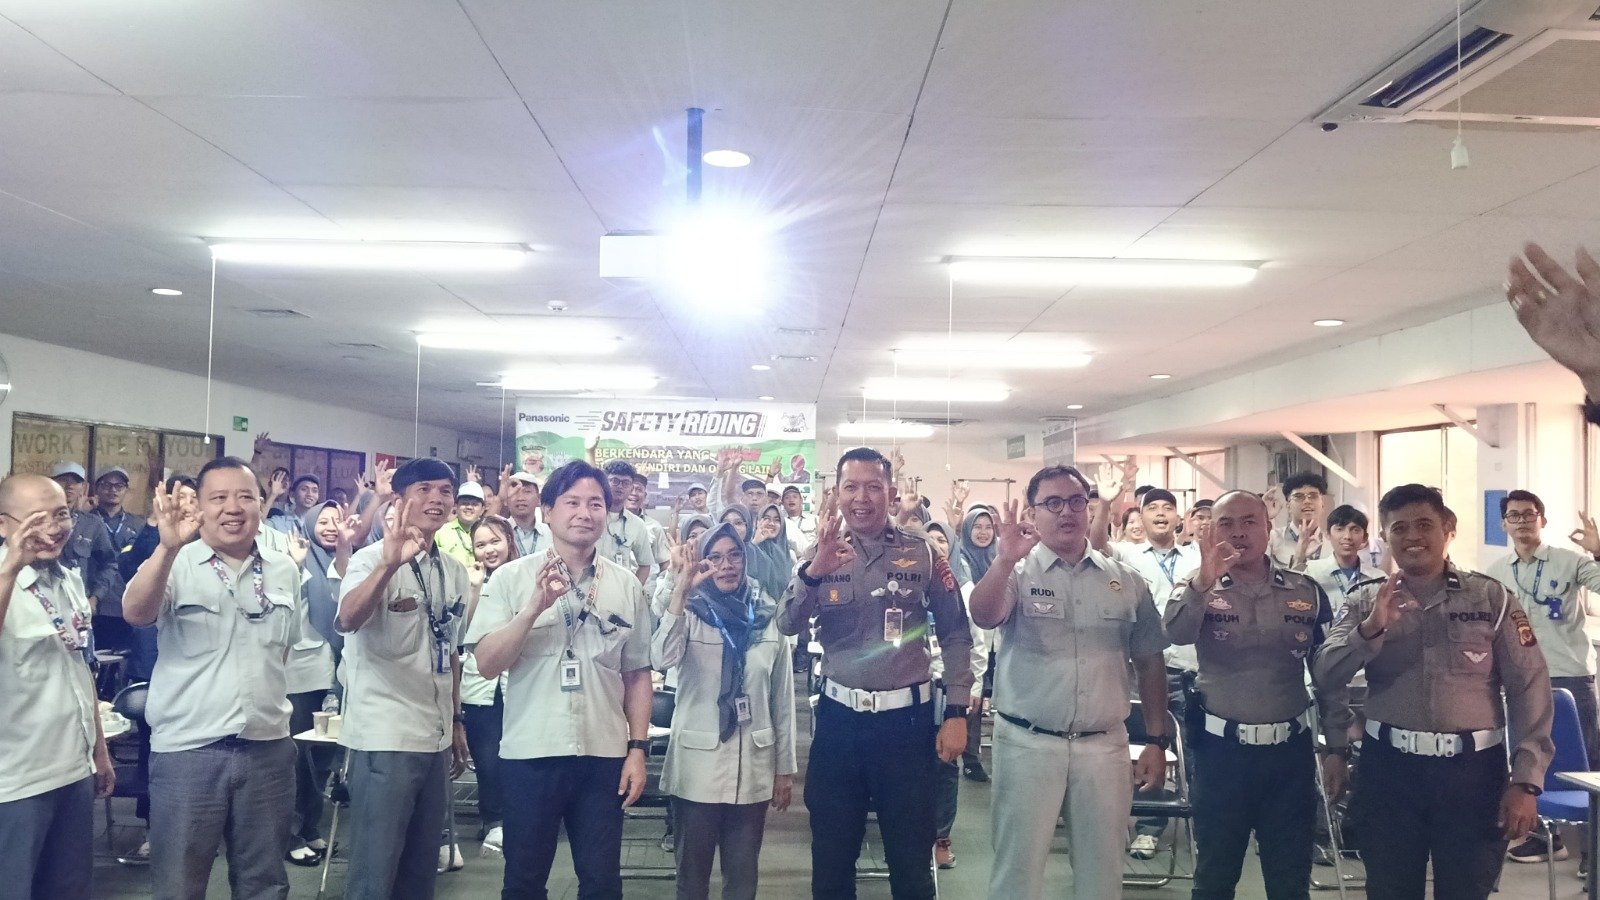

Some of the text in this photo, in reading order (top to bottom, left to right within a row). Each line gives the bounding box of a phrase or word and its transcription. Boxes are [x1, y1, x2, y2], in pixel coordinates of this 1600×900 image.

[519, 413, 570, 423] Panasonic
[601, 410, 757, 436] SAFETY RIDING
[15, 433, 73, 455] WORK
[595, 448, 710, 461] BERKENDARA YANG
[685, 463, 706, 474] DAN
[887, 572, 922, 583] POLRI
[1030, 587, 1055, 598] RUDI
[1449, 611, 1493, 622] POLRI
